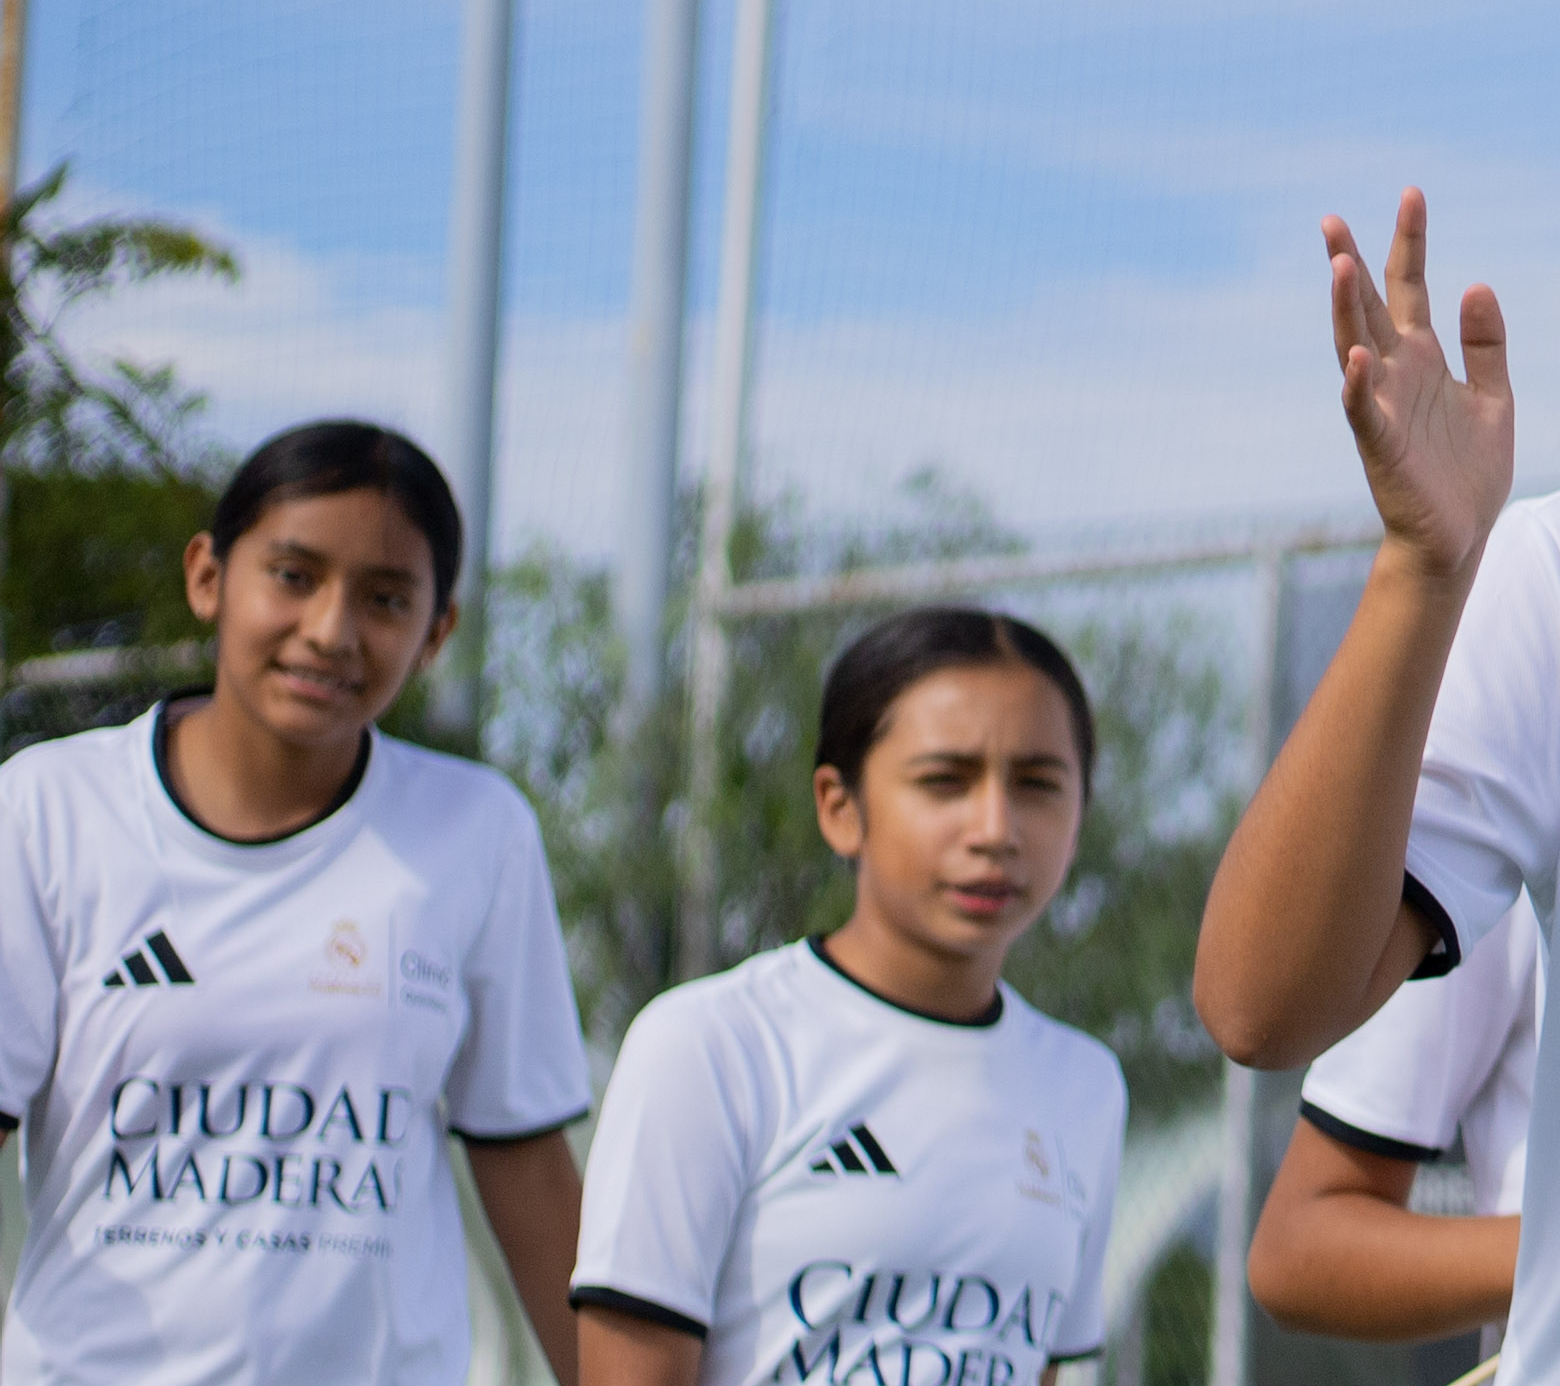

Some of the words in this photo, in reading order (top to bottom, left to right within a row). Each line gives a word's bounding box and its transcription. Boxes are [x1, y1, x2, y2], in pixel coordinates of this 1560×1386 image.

[111, 1077, 411, 1145] CIUDAD
[97, 1223, 206, 1251] TERRENOS
[211, 1228, 225, 1248] Y
[235, 1229, 312, 1253] CASAS
